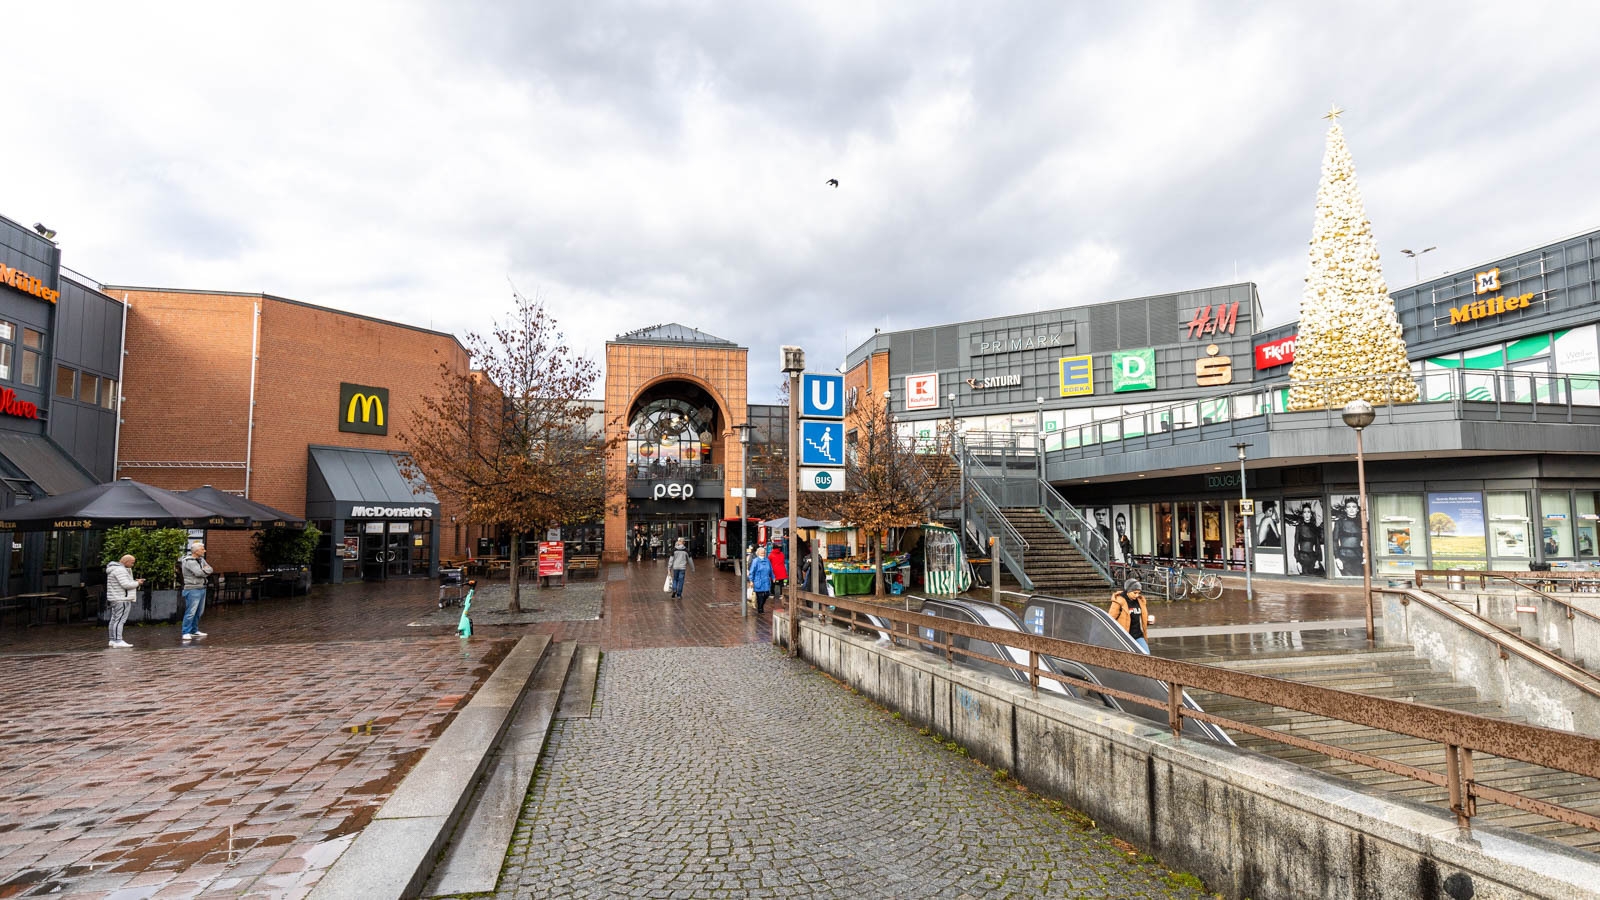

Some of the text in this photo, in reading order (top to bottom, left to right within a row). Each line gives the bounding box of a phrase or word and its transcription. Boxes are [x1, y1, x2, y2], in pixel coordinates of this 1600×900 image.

[0, 263, 60, 304] Müller
[1449, 292, 1534, 325] Müller
[1187, 301, 1240, 339] H&M
[980, 332, 1061, 354] PRIMARK
[1064, 359, 1089, 386] E
[1122, 356, 1146, 378] D
[984, 374, 1021, 388] SATURN
[1063, 385, 1091, 393] EDEKA
[812, 380, 835, 411] U
[815, 474, 832, 485] BUS
[653, 483, 694, 500] pep
[351, 505, 433, 518] McDonald's
